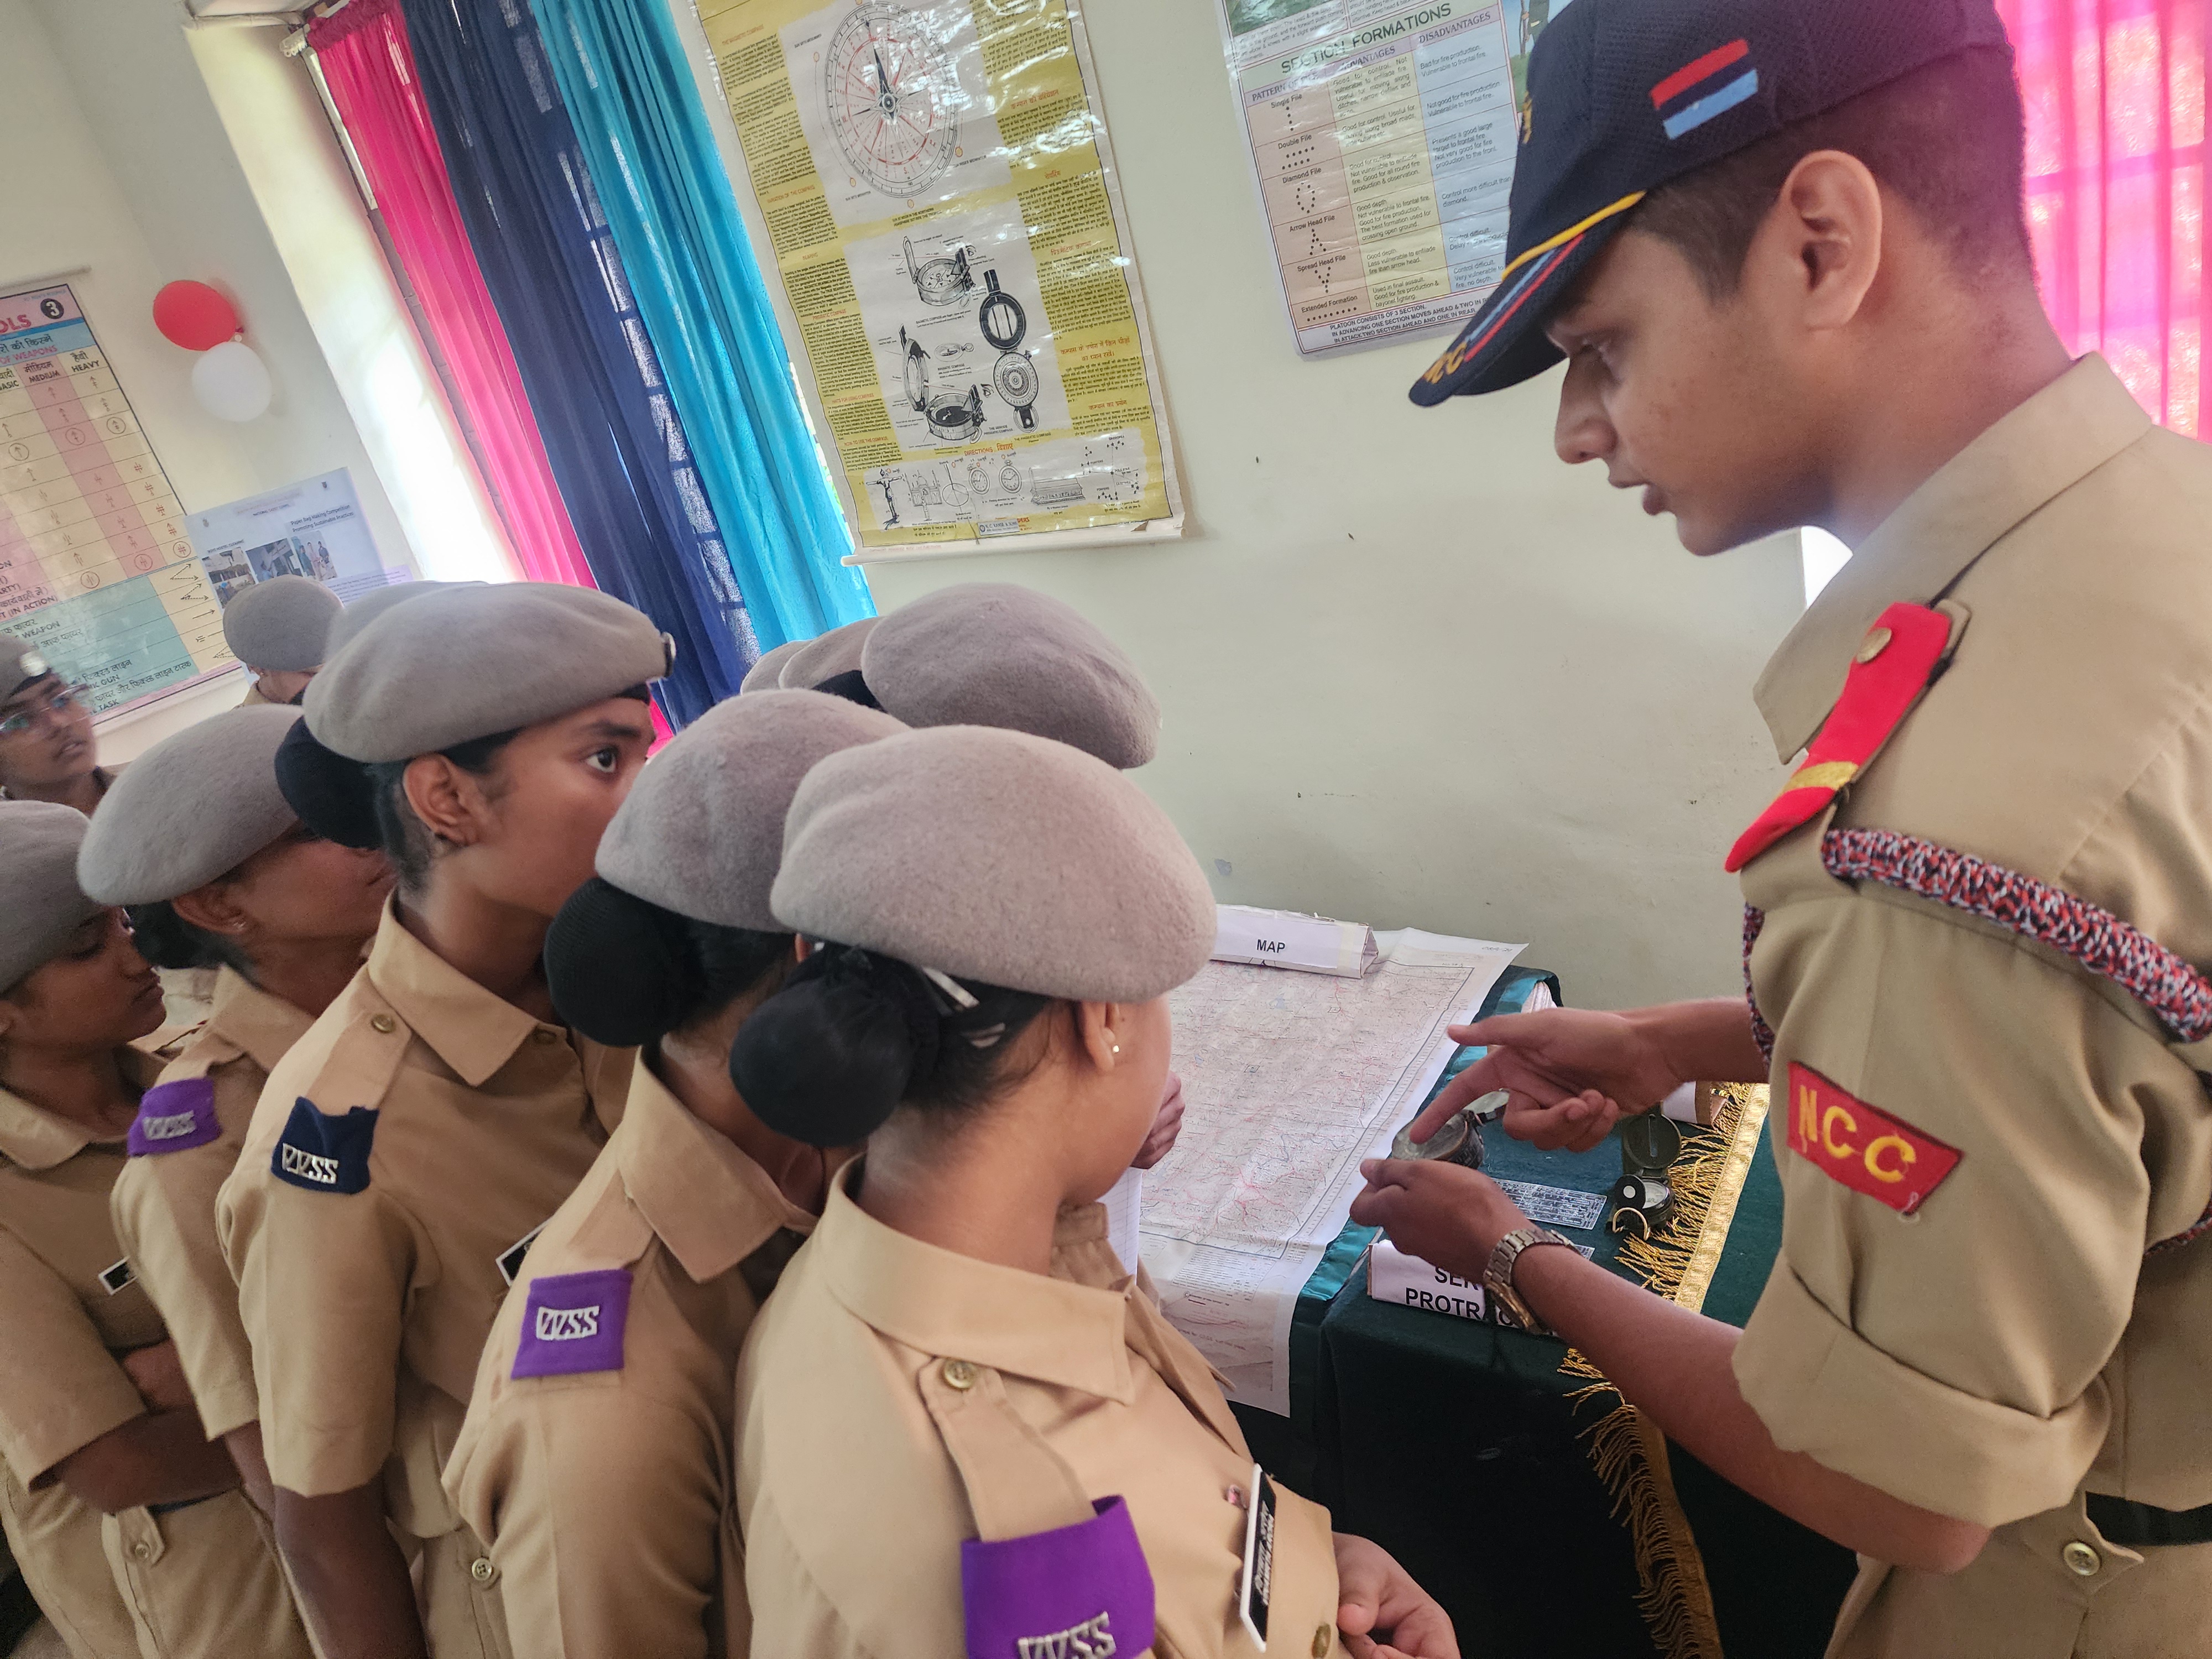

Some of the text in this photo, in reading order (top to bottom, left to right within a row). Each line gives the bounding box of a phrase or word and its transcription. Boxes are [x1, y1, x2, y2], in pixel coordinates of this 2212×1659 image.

[1353, 3, 1451, 48] FORMATIONS
[1419, 12, 1491, 43] DISADVANTAGES
[1271, 94, 1302, 108] Single File
[1278, 134, 1312, 149] Double File
[1282, 168, 1322, 184] Diamond File
[1290, 223, 1306, 232] Arrow
[1297, 262, 1318, 272] Spread
[46, 301, 60, 316] 3
[1301, 295, 1358, 313] Extended Formation
[1330, 320, 1355, 330] PLATOON
[1357, 313, 1385, 324] CONSISTS
[1339, 324, 1370, 335] ADVANCING
[1384, 315, 1410, 325] SECTION
[1411, 310, 1432, 319] MOVES
[1433, 305, 1453, 314] AHEAD
[1460, 300, 1473, 309] TWO
[1341, 332, 1362, 341] ATTACK
[1362, 328, 1375, 336] TWO
[1376, 325, 1401, 335] SECTION
[1402, 320, 1422, 329] AHEAD
[13, 345, 58, 360] WEAPONS
[71, 361, 100, 372] HEAVY
[29, 370, 60, 383] MEDIUM
[964, 447, 993, 456] DIRECTIONS
[22, 621, 60, 638] WEAPON
[101, 674, 119, 685] GUN
[98, 699, 119, 711] TASK
[1256, 939, 1286, 953] MAP
[1798, 1084, 1916, 1183] NCC
